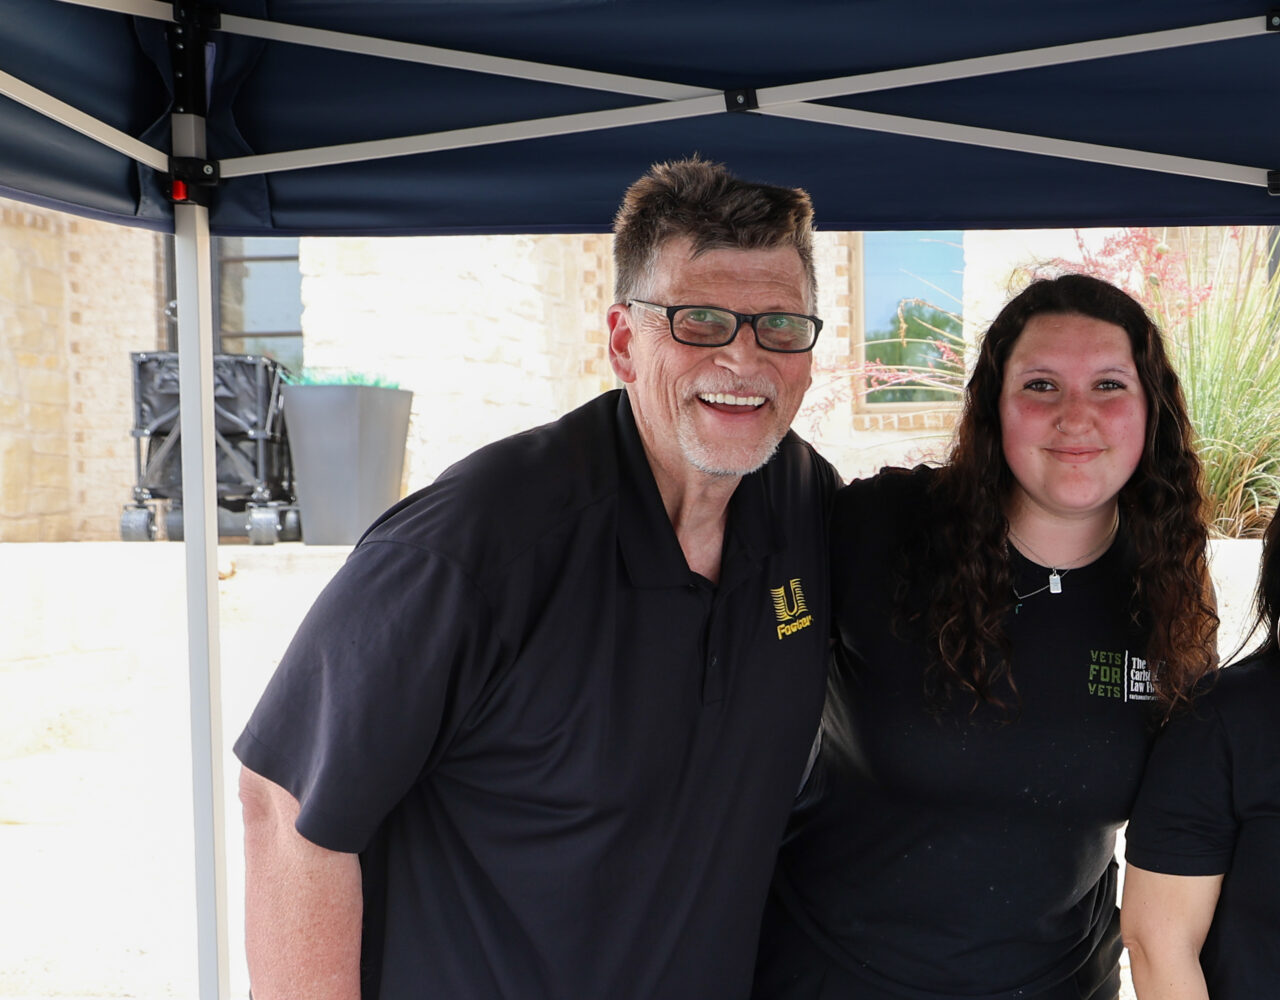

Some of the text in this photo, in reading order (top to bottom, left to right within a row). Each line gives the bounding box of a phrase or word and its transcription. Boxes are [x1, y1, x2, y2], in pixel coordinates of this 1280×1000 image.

[1090, 650, 1122, 665] VETS
[1131, 657, 1147, 670] The
[1089, 664, 1122, 684] FOR
[1087, 682, 1121, 698] VETS
[1130, 680, 1146, 693] Law
